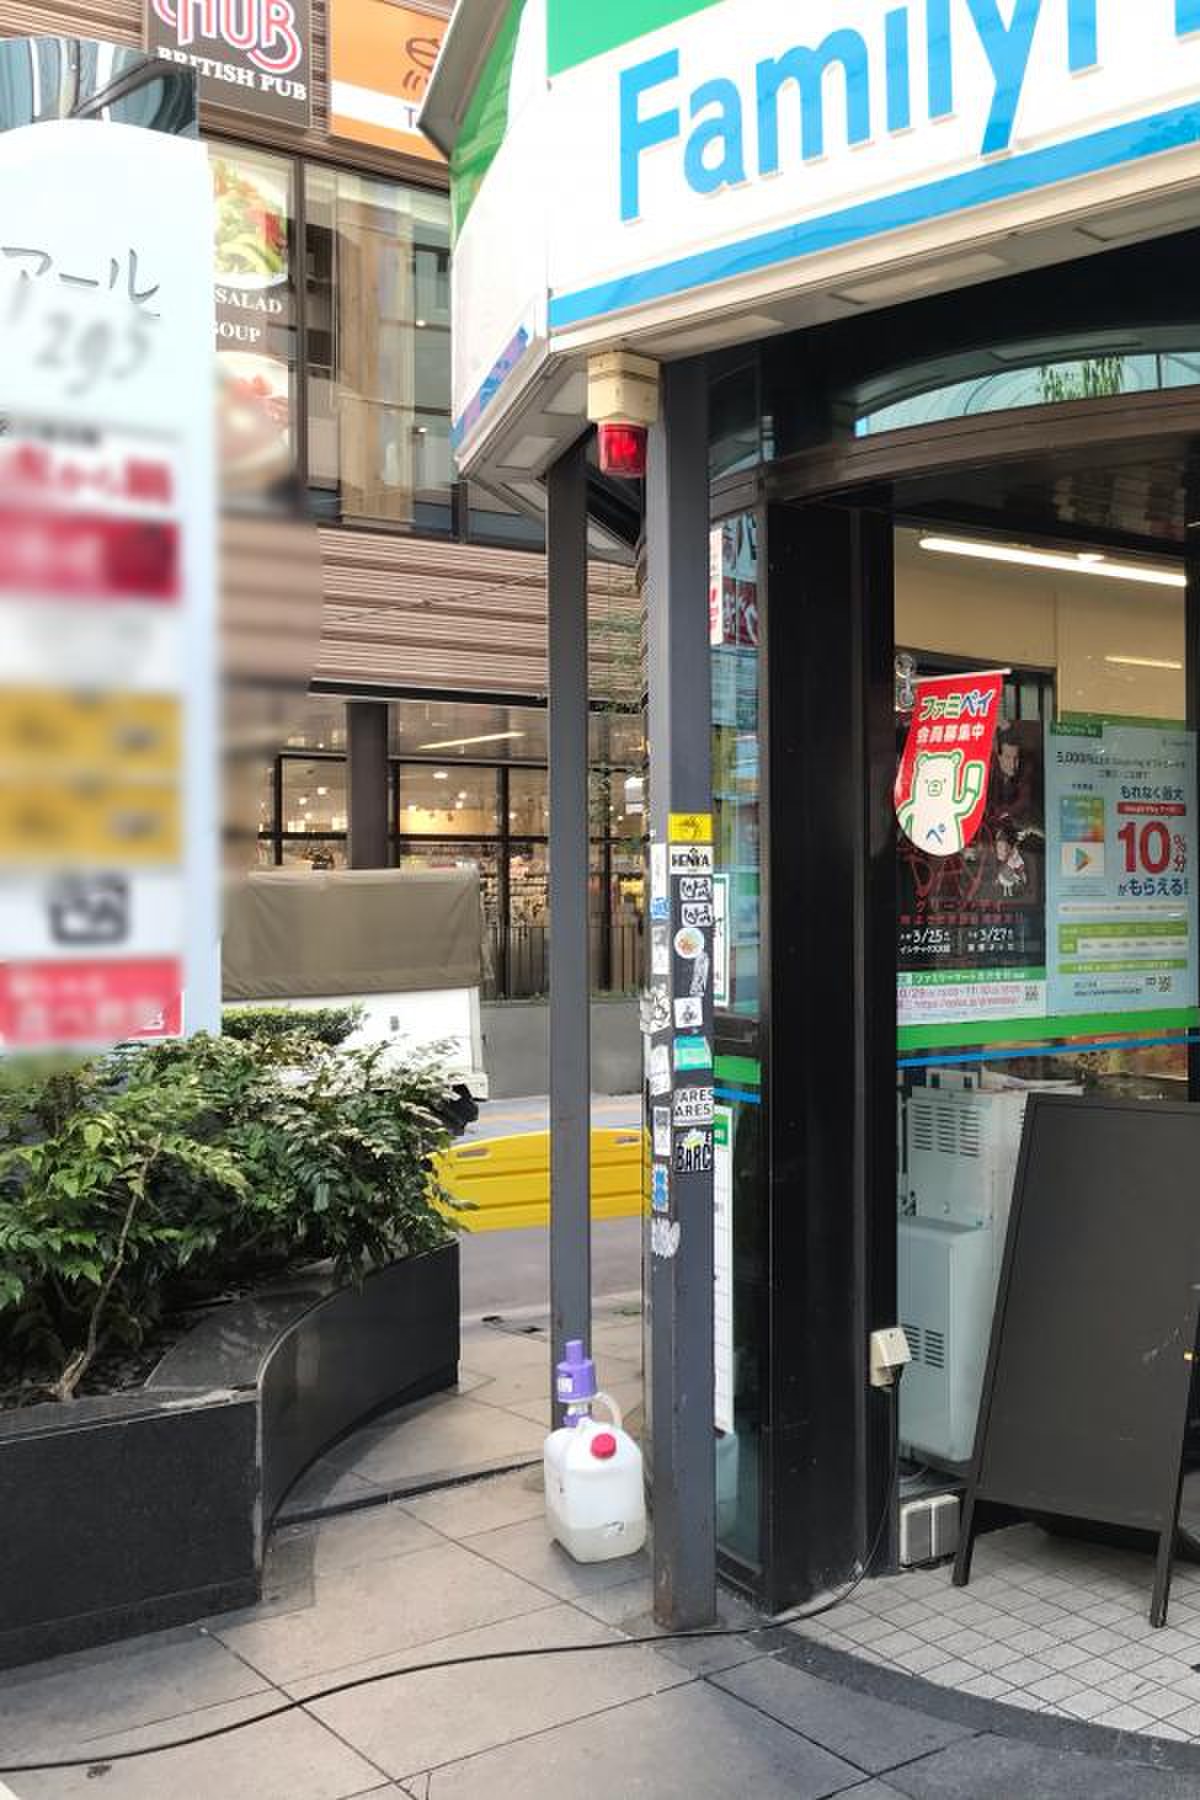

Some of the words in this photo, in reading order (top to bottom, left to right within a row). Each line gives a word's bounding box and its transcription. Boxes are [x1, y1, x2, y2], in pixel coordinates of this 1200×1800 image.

[258, 74, 308, 101] PUB
[214, 287, 283, 315] SALAD
[918, 688, 996, 720] ファミペイ
